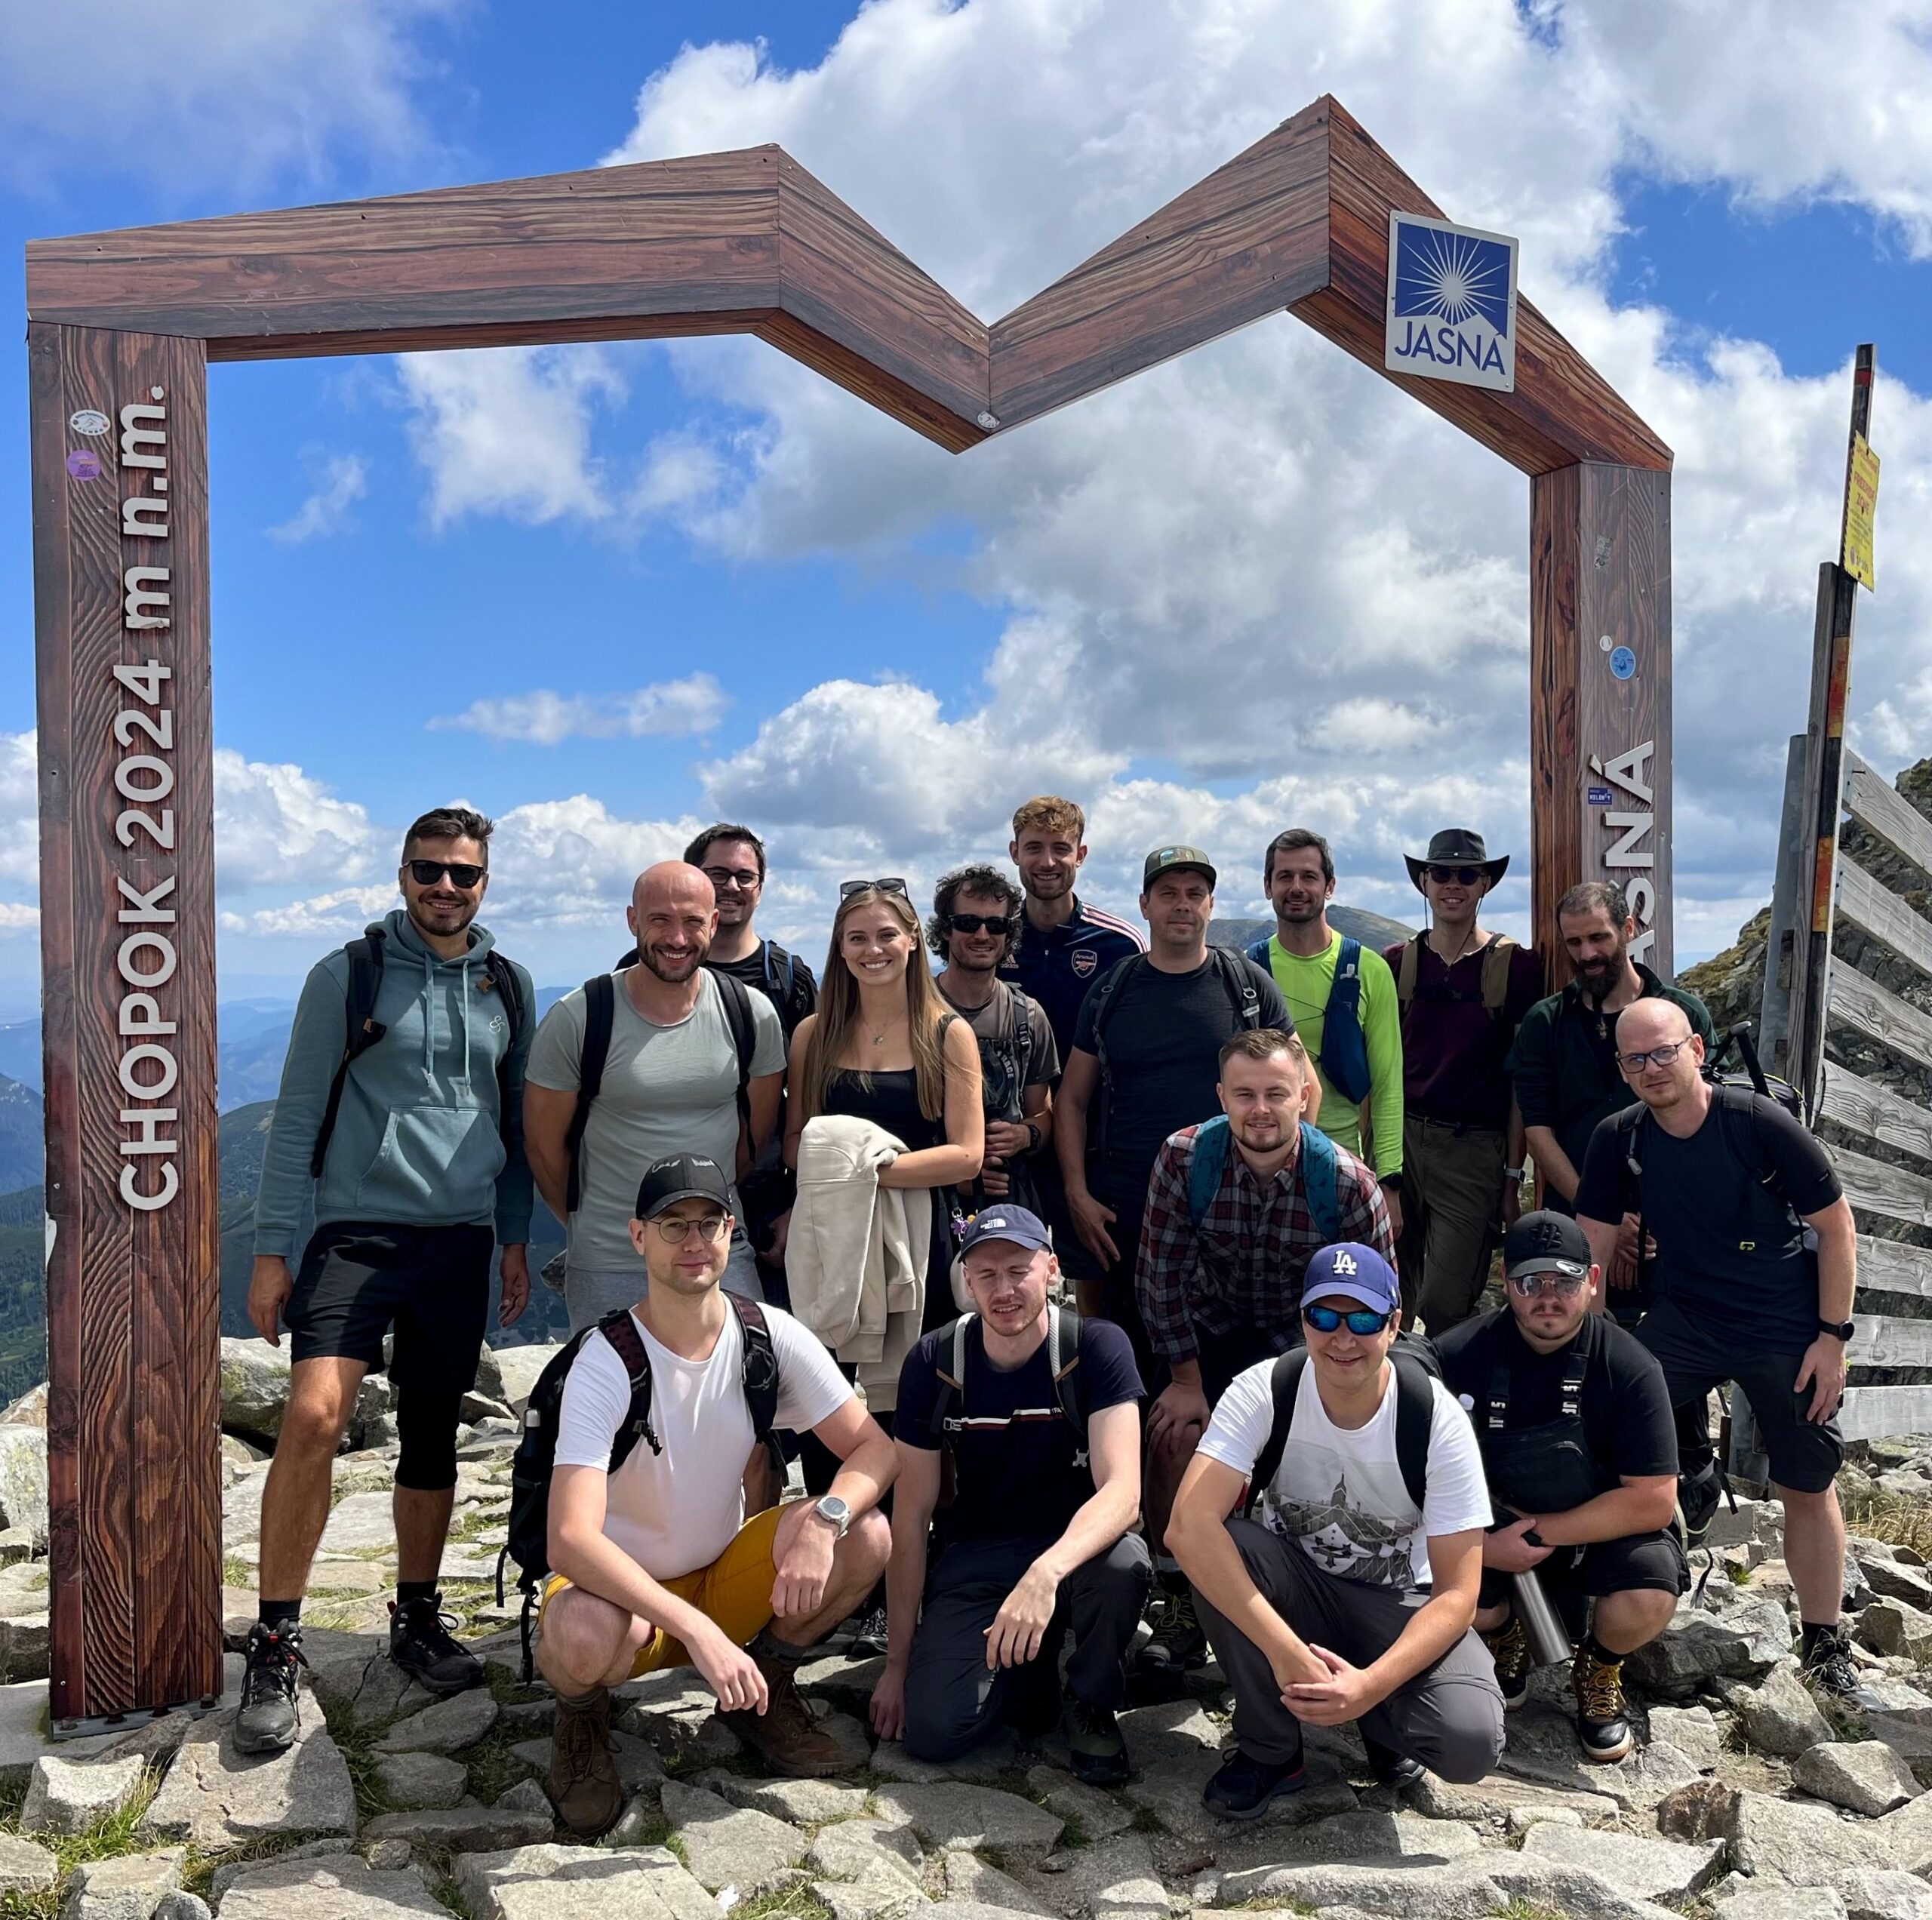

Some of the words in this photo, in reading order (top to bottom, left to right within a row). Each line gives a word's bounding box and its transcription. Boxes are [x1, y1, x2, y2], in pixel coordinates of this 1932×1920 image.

[119, 385, 168, 537] n.m.
[124, 566, 171, 629] m
[113, 659, 174, 850] 2024
[117, 875, 179, 1211] CHOPOK
[1332, 1250, 1357, 1275] LA
